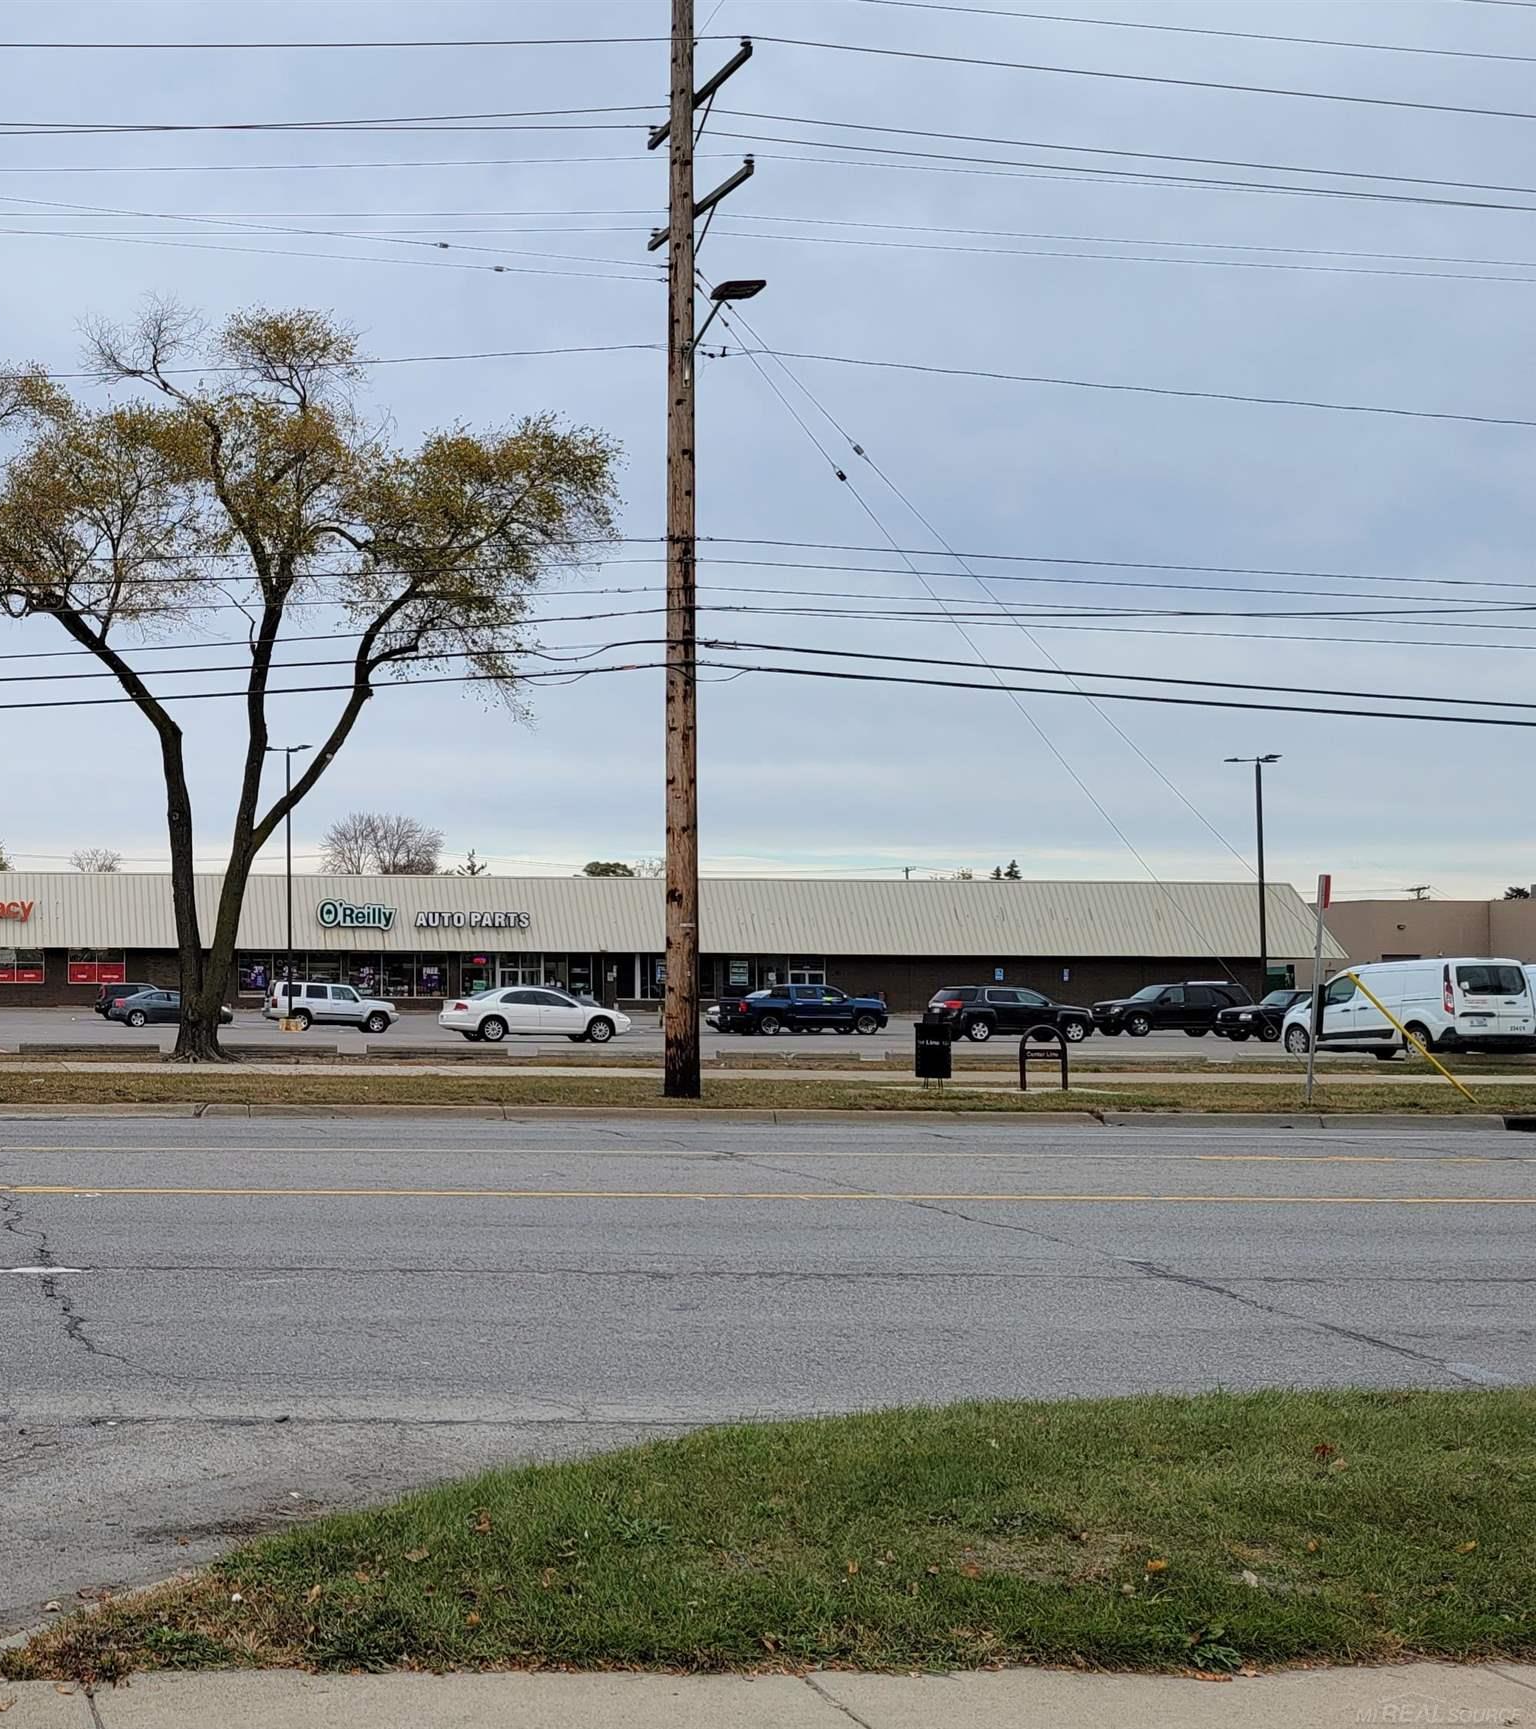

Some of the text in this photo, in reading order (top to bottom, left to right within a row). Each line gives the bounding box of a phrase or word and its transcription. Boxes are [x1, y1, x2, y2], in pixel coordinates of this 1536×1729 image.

[318, 899, 531, 929] O'Reilly AUTO PARTS
[1026, 1050, 1045, 1058] Center
